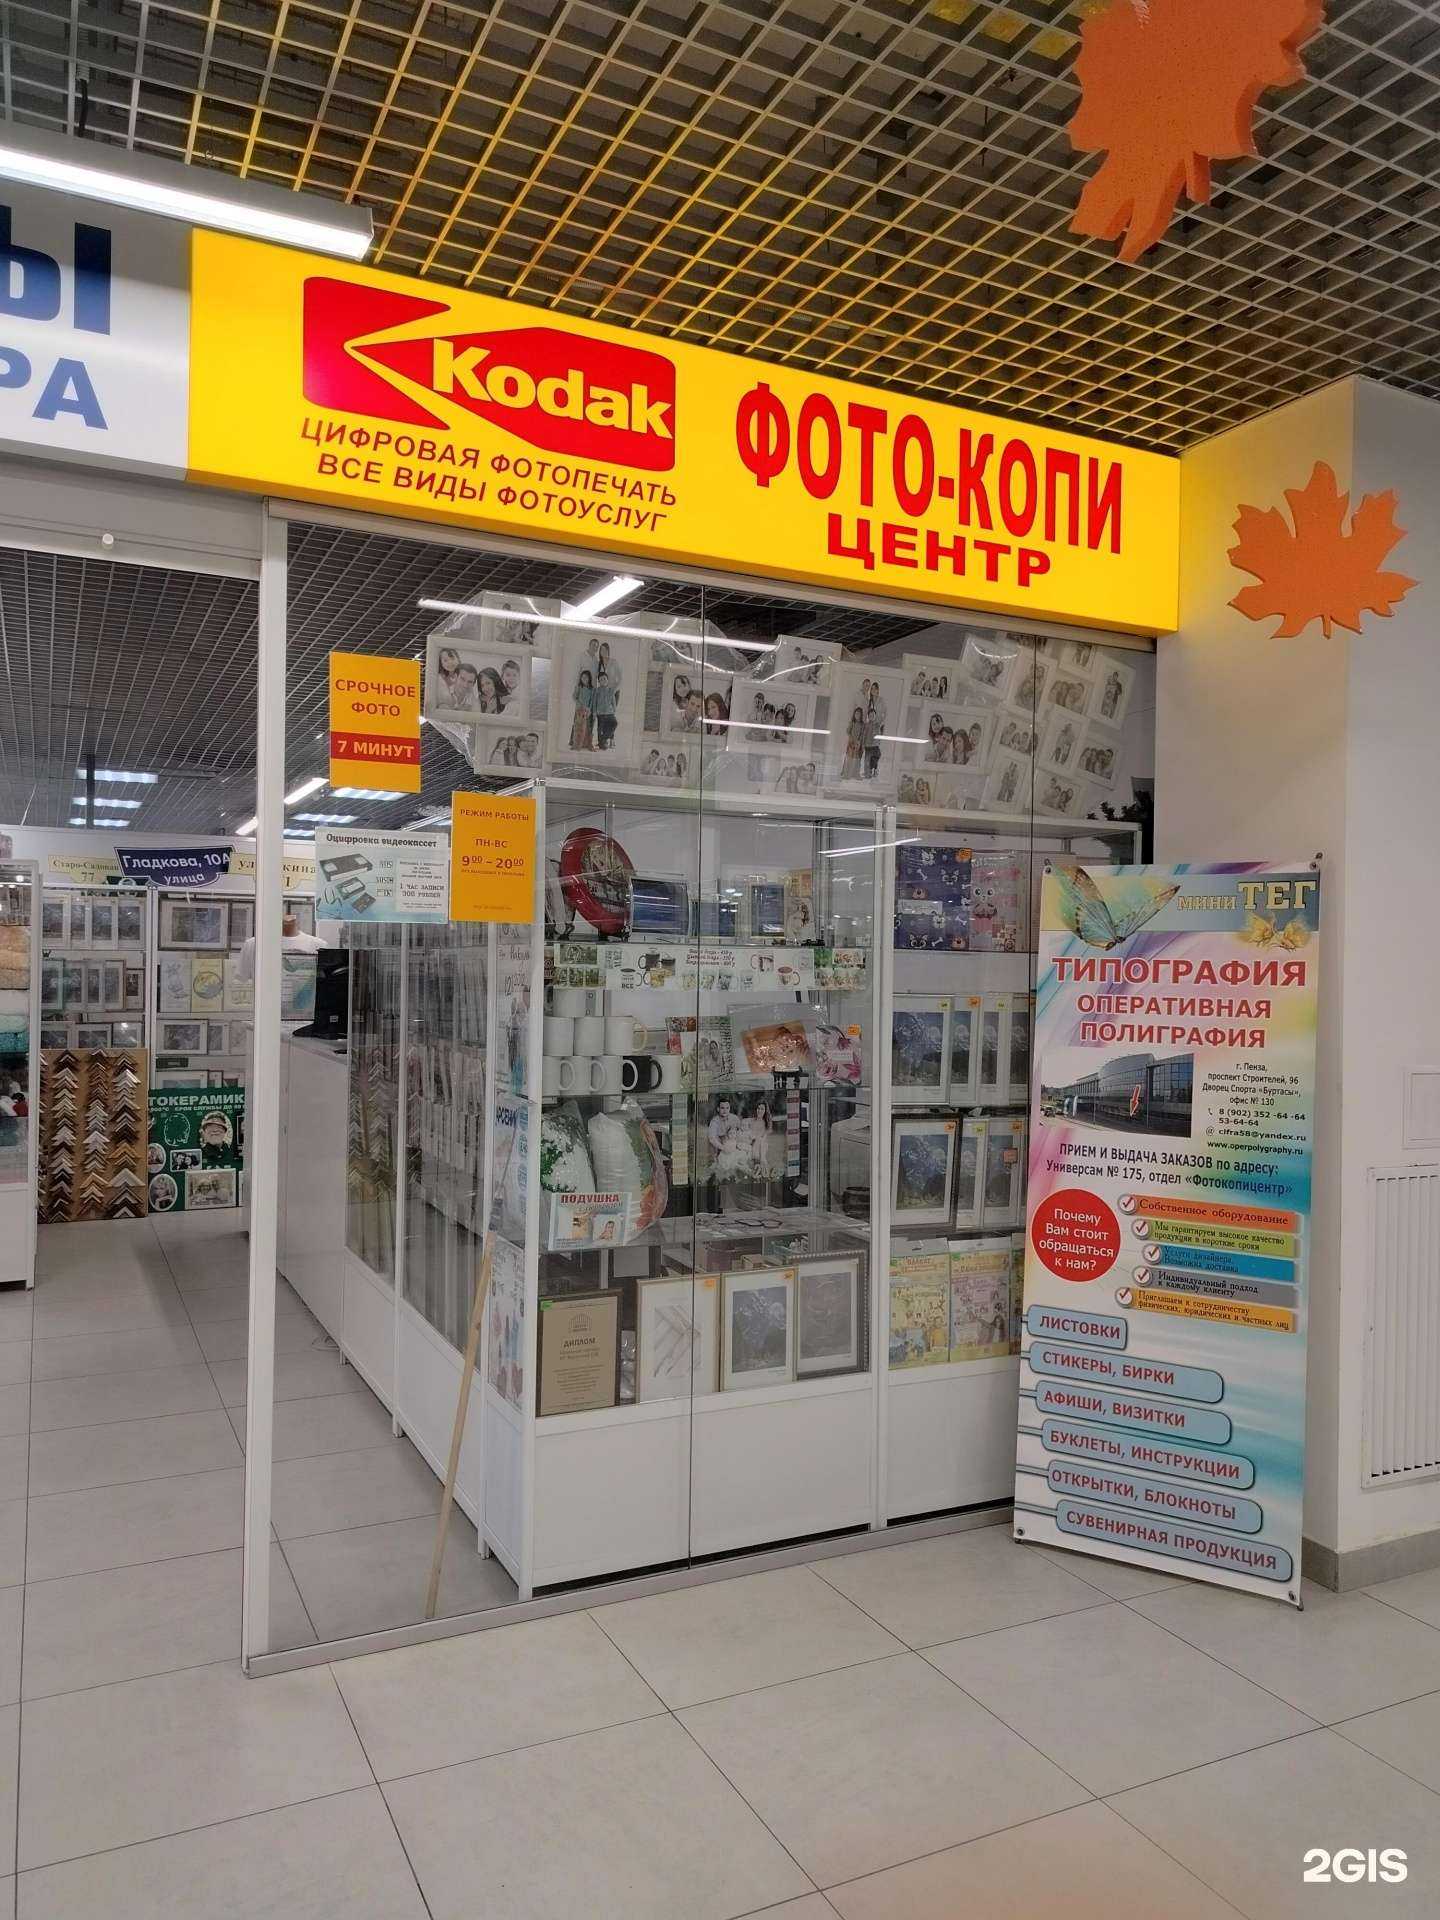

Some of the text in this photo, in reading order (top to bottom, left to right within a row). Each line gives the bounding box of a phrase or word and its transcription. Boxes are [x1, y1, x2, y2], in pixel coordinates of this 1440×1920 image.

[431, 338, 673, 439] Kodak
[300, 417, 677, 506] ЦИФРОВАЯ ФОТОПЕЧАТЬ
[736, 381, 1122, 554] ФОТО-КОПИ
[317, 453, 667, 532] ВСЕ ВИДЫ ФОТОУСЛУГ
[827, 512, 1051, 587] ЦЕНТР
[335, 679, 416, 698] СРОЧНОЕ
[351, 702, 400, 717] ФОТО
[337, 740, 415, 758] 7 МИНУТ
[460, 809, 529, 821] РЕЖИМ РАБОТЫ
[326, 834, 437, 848] Оцифровка видеокассет
[475, 839, 508, 848] ПН-ВС
[123, 855, 202, 869] Гладкова,
[164, 873, 205, 885] улица
[1238, 880, 1317, 910] ТЕГ
[1052, 957, 1306, 987] ТИПОГРАФИЯ
[1077, 995, 1271, 1018] ОПЕРАТИВНАЯ
[1081, 1022, 1265, 1048] ПОЛИГРАФИЯ
[1243, 1063, 1268, 1072] Пенза,
[1202, 1083, 1229, 1092] Дворец
[1230, 1084, 1256, 1094] Спорта
[1207, 1073, 1299, 1085] проспект Строителей, 96
[1229, 1096, 1249, 1105] офис
[1261, 1098, 1275, 1106] 130
[1218, 1117, 1259, 1126] 53-64-64
[1226, 1108, 1251, 1118] (902)
[1253, 1110, 1271, 1118] 352
[1218, 1128, 1306, 1141] cifra58@yandex.ru
[1207, 1141, 1303, 1155] www.operpolygraphy.ru
[1059, 1143, 1279, 1176] ПРИЕМ И ВЫДАЧА ЗАКАЗОВ по адресу:
[1046, 1160, 1293, 1197] Универсам № 175, отдел «Фотокопицентр»
[561, 1194, 620, 1204] ПОДУШКА
[1054, 1208, 1102, 1223] Почему
[1139, 1199, 1288, 1225] Собственное оборудование
[1045, 1223, 1109, 1241] Вам стоит
[1154, 1231, 1192, 1243] продукции
[1202, 1237, 1235, 1248] короткие
[1238, 1242, 1260, 1252] сроки
[1155, 1221, 1285, 1245] Мы гарантируем высокое качество
[1039, 1239, 1114, 1258] обращаться
[1055, 1257, 1096, 1270] к нам?
[1157, 1270, 1258, 1294] Индивидуальный подход
[1165, 1282, 1200, 1293] каждому
[1203, 1287, 1236, 1298] клиенту
[1138, 1290, 1183, 1305] Приглашаем
[1192, 1300, 1250, 1314] сотрудничеству
[1039, 1315, 1121, 1339] ЛИСТОВКИ
[1184, 1307, 1232, 1321] юридических
[1242, 1316, 1272, 1327] частных
[1275, 1321, 1289, 1330] лиц
[1043, 1351, 1175, 1385] СТИКЕРЫ, БИРКИ
[1044, 1390, 1185, 1428] АФИШИ, ВИЗИТКИ
[1050, 1430, 1240, 1479] БУКЛЕТЫ, ИНСТРУКЦИИ
[1052, 1469, 1236, 1520] ОТКРЫТКИ, БЛОКНОТЫ
[1066, 1510, 1277, 1570] СУВЕНИРНАЯ ПРОДУКЦИЯ
